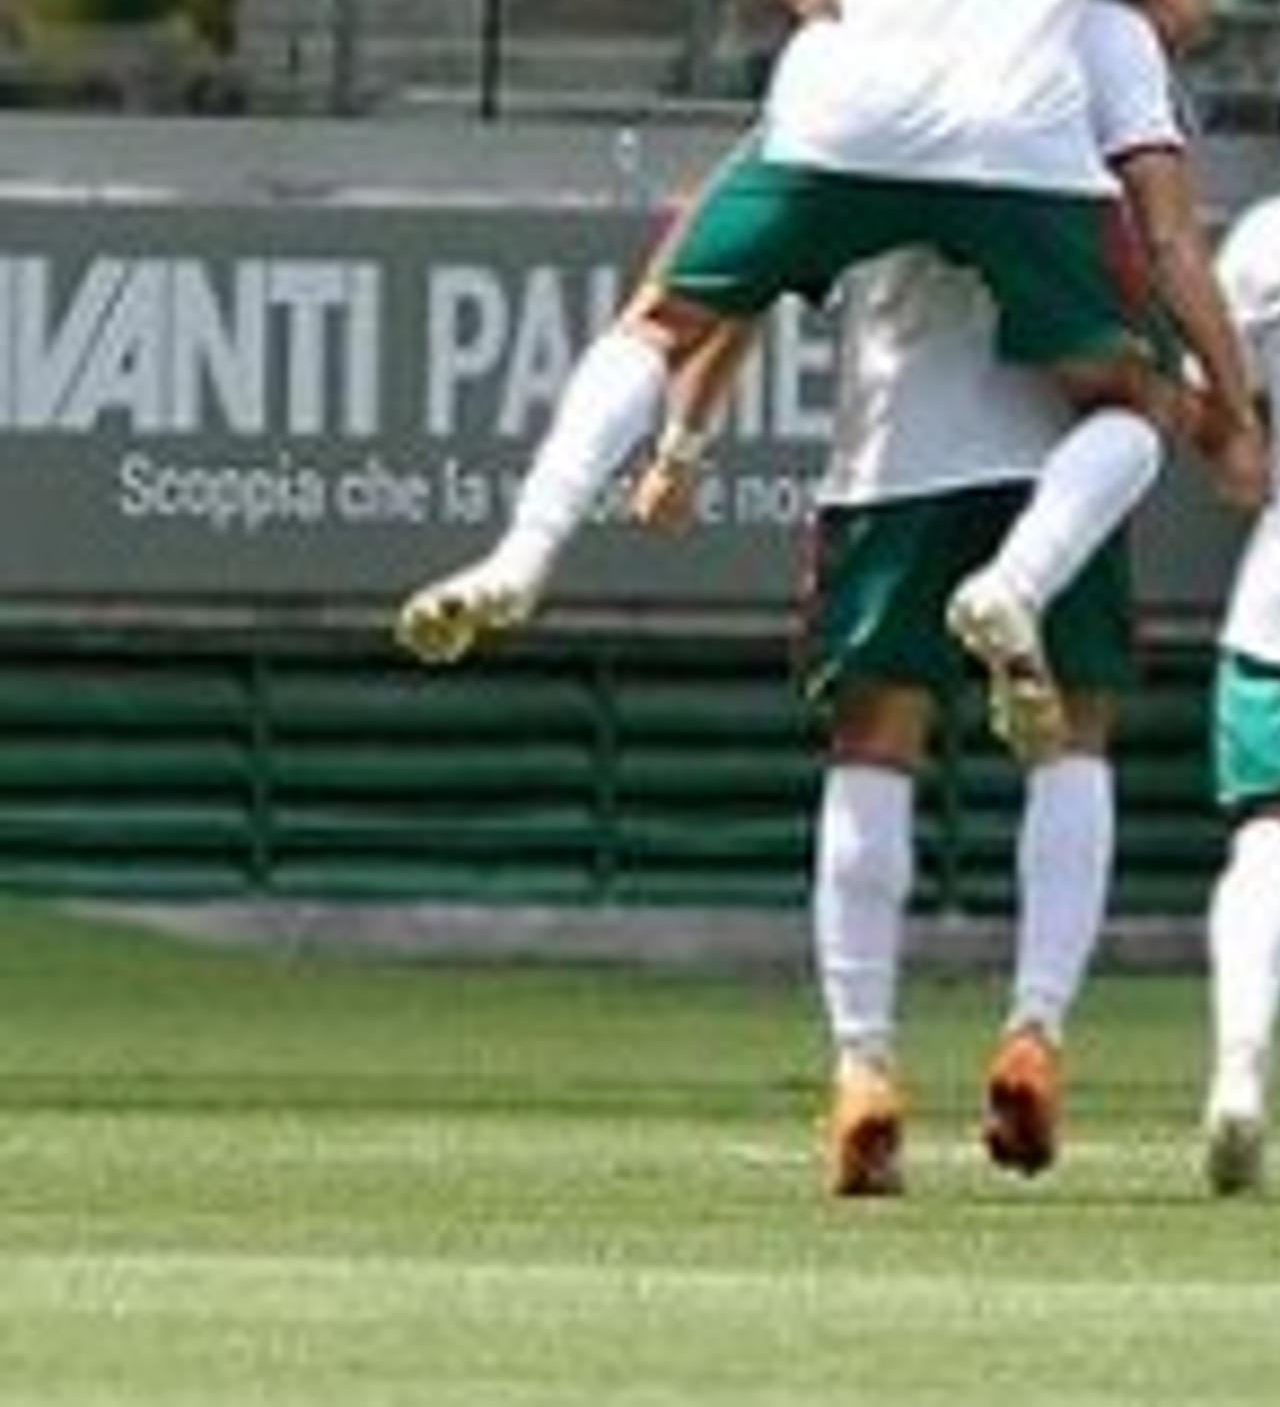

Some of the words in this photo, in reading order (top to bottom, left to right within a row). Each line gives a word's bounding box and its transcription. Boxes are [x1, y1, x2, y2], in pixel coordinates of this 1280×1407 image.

[0, 257, 382, 437] VANTI
[120, 451, 326, 533] Scoppia
[444, 457, 488, 523] la
